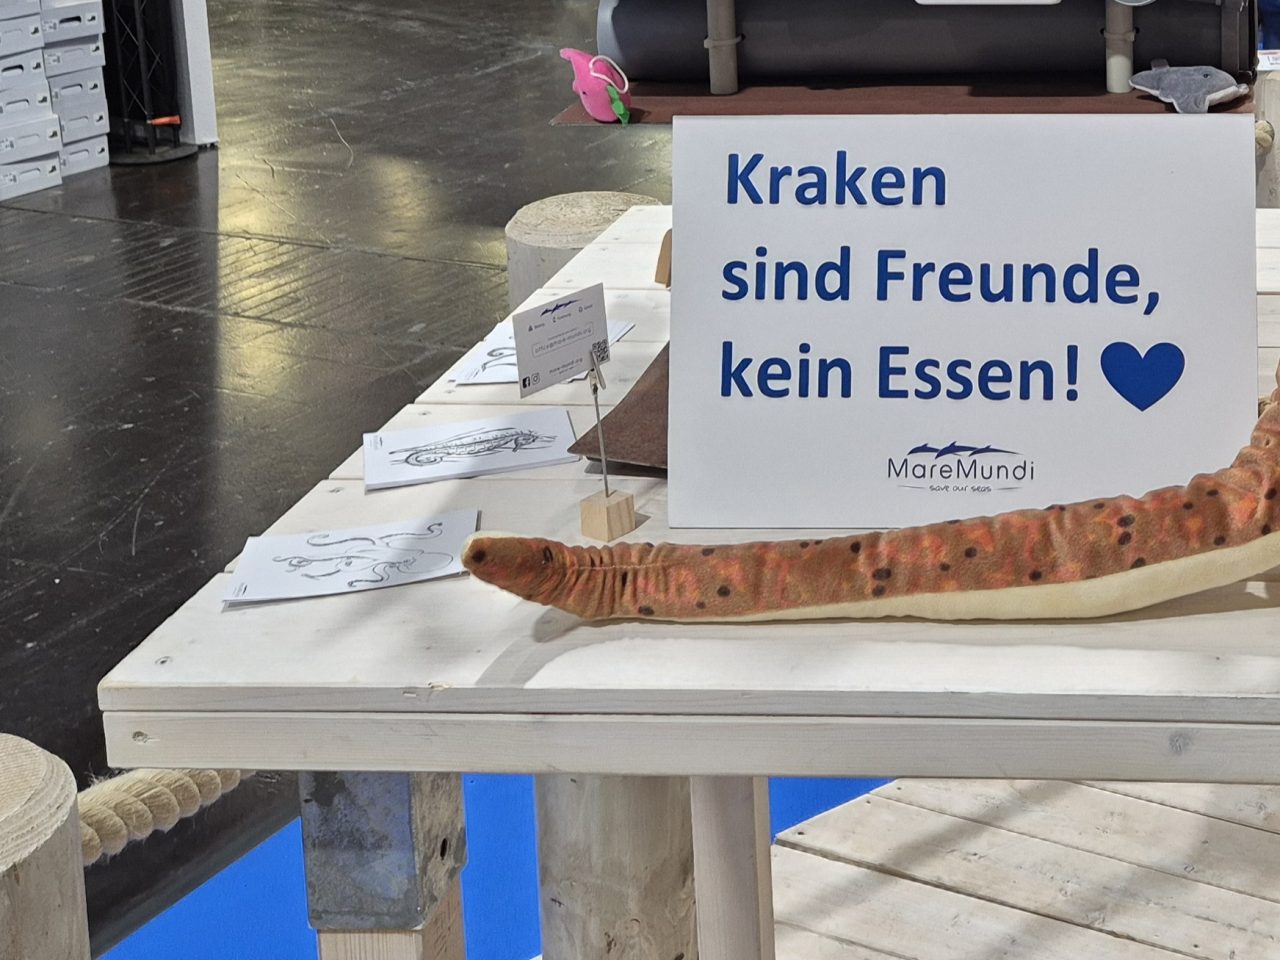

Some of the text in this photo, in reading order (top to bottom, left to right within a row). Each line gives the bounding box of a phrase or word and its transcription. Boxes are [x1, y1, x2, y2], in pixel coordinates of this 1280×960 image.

[726, 150, 946, 206] Kraken
[721, 246, 1161, 316] sind Freunde,
[720, 341, 1080, 402] kein Essen!
[887, 457, 1035, 481] MareMundi
[929, 484, 992, 493] save our seas
